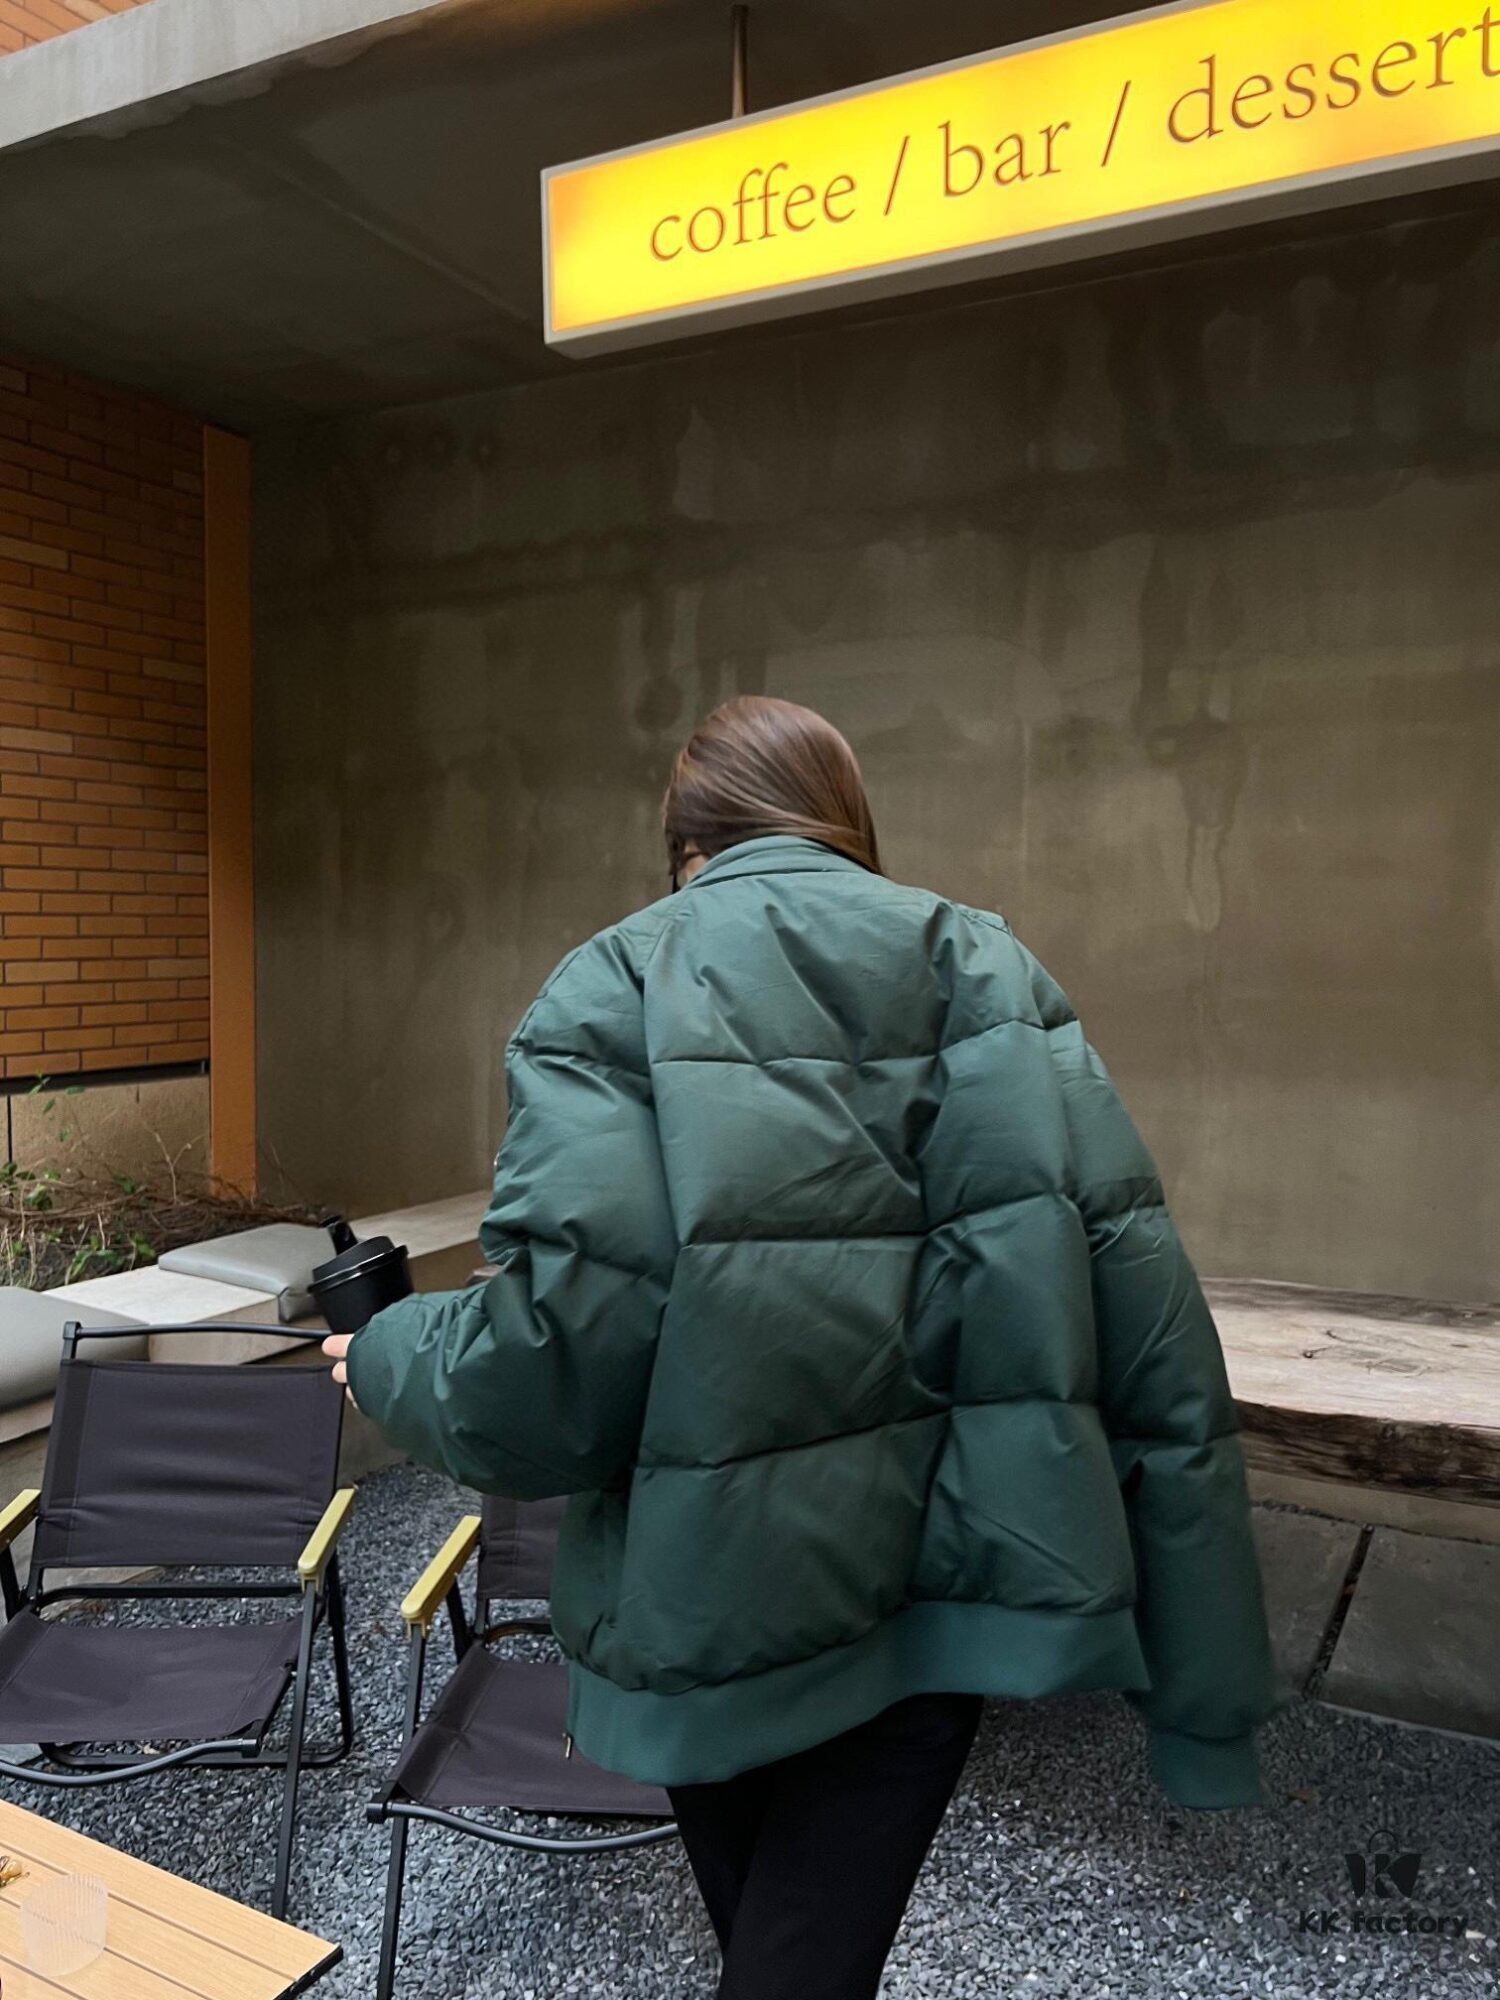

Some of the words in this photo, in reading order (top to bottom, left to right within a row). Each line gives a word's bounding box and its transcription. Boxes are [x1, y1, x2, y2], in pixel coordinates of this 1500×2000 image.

[650, 161, 856, 262] coffee
[884, 136, 910, 215] /
[937, 120, 1071, 198] bar
[1100, 80, 1131, 167] /
[1167, 6, 1500, 144] dessert
